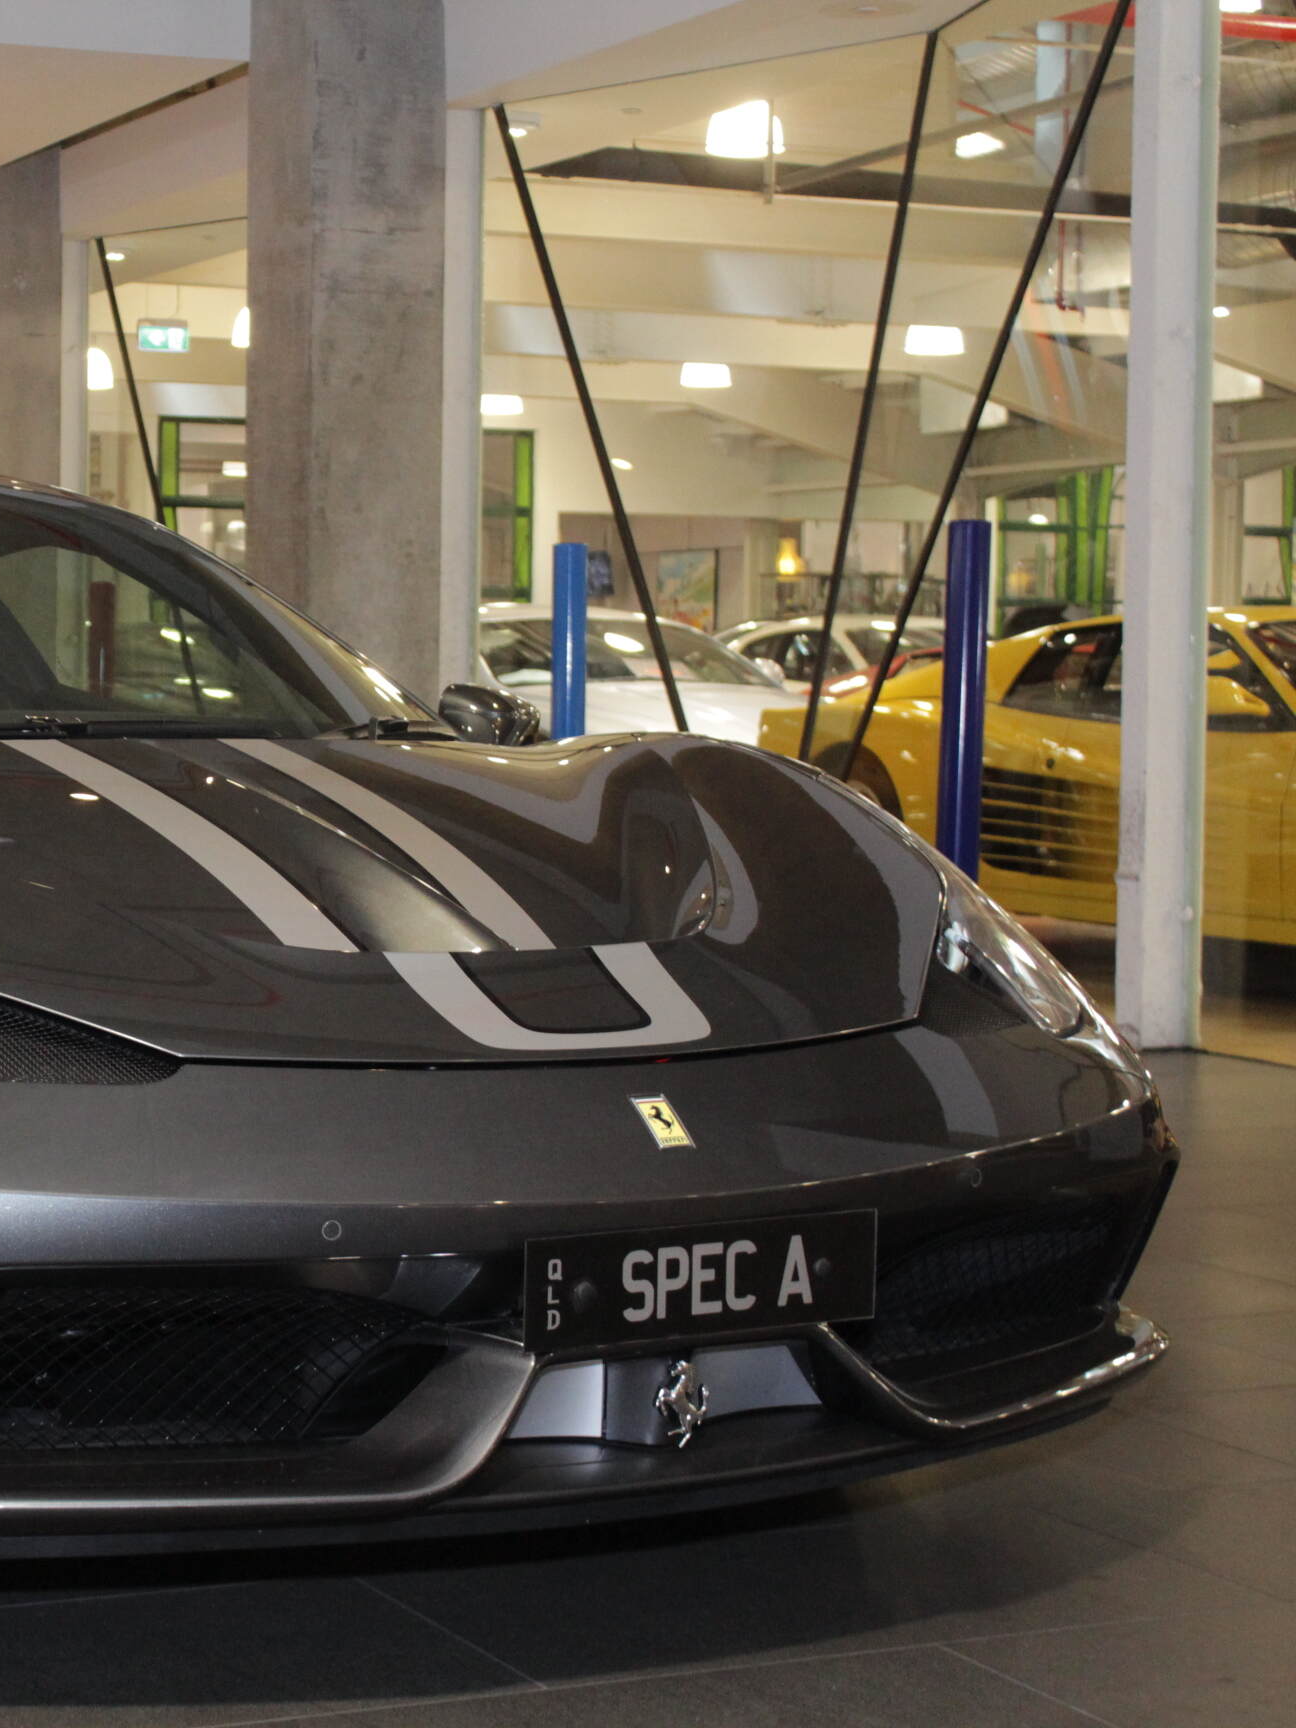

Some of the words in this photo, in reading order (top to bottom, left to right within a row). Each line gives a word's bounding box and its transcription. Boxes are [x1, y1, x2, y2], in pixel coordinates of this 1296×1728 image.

[547, 1258, 562, 1331] QLD
[622, 1239, 757, 1323] SPEC
[777, 1234, 813, 1307] A
